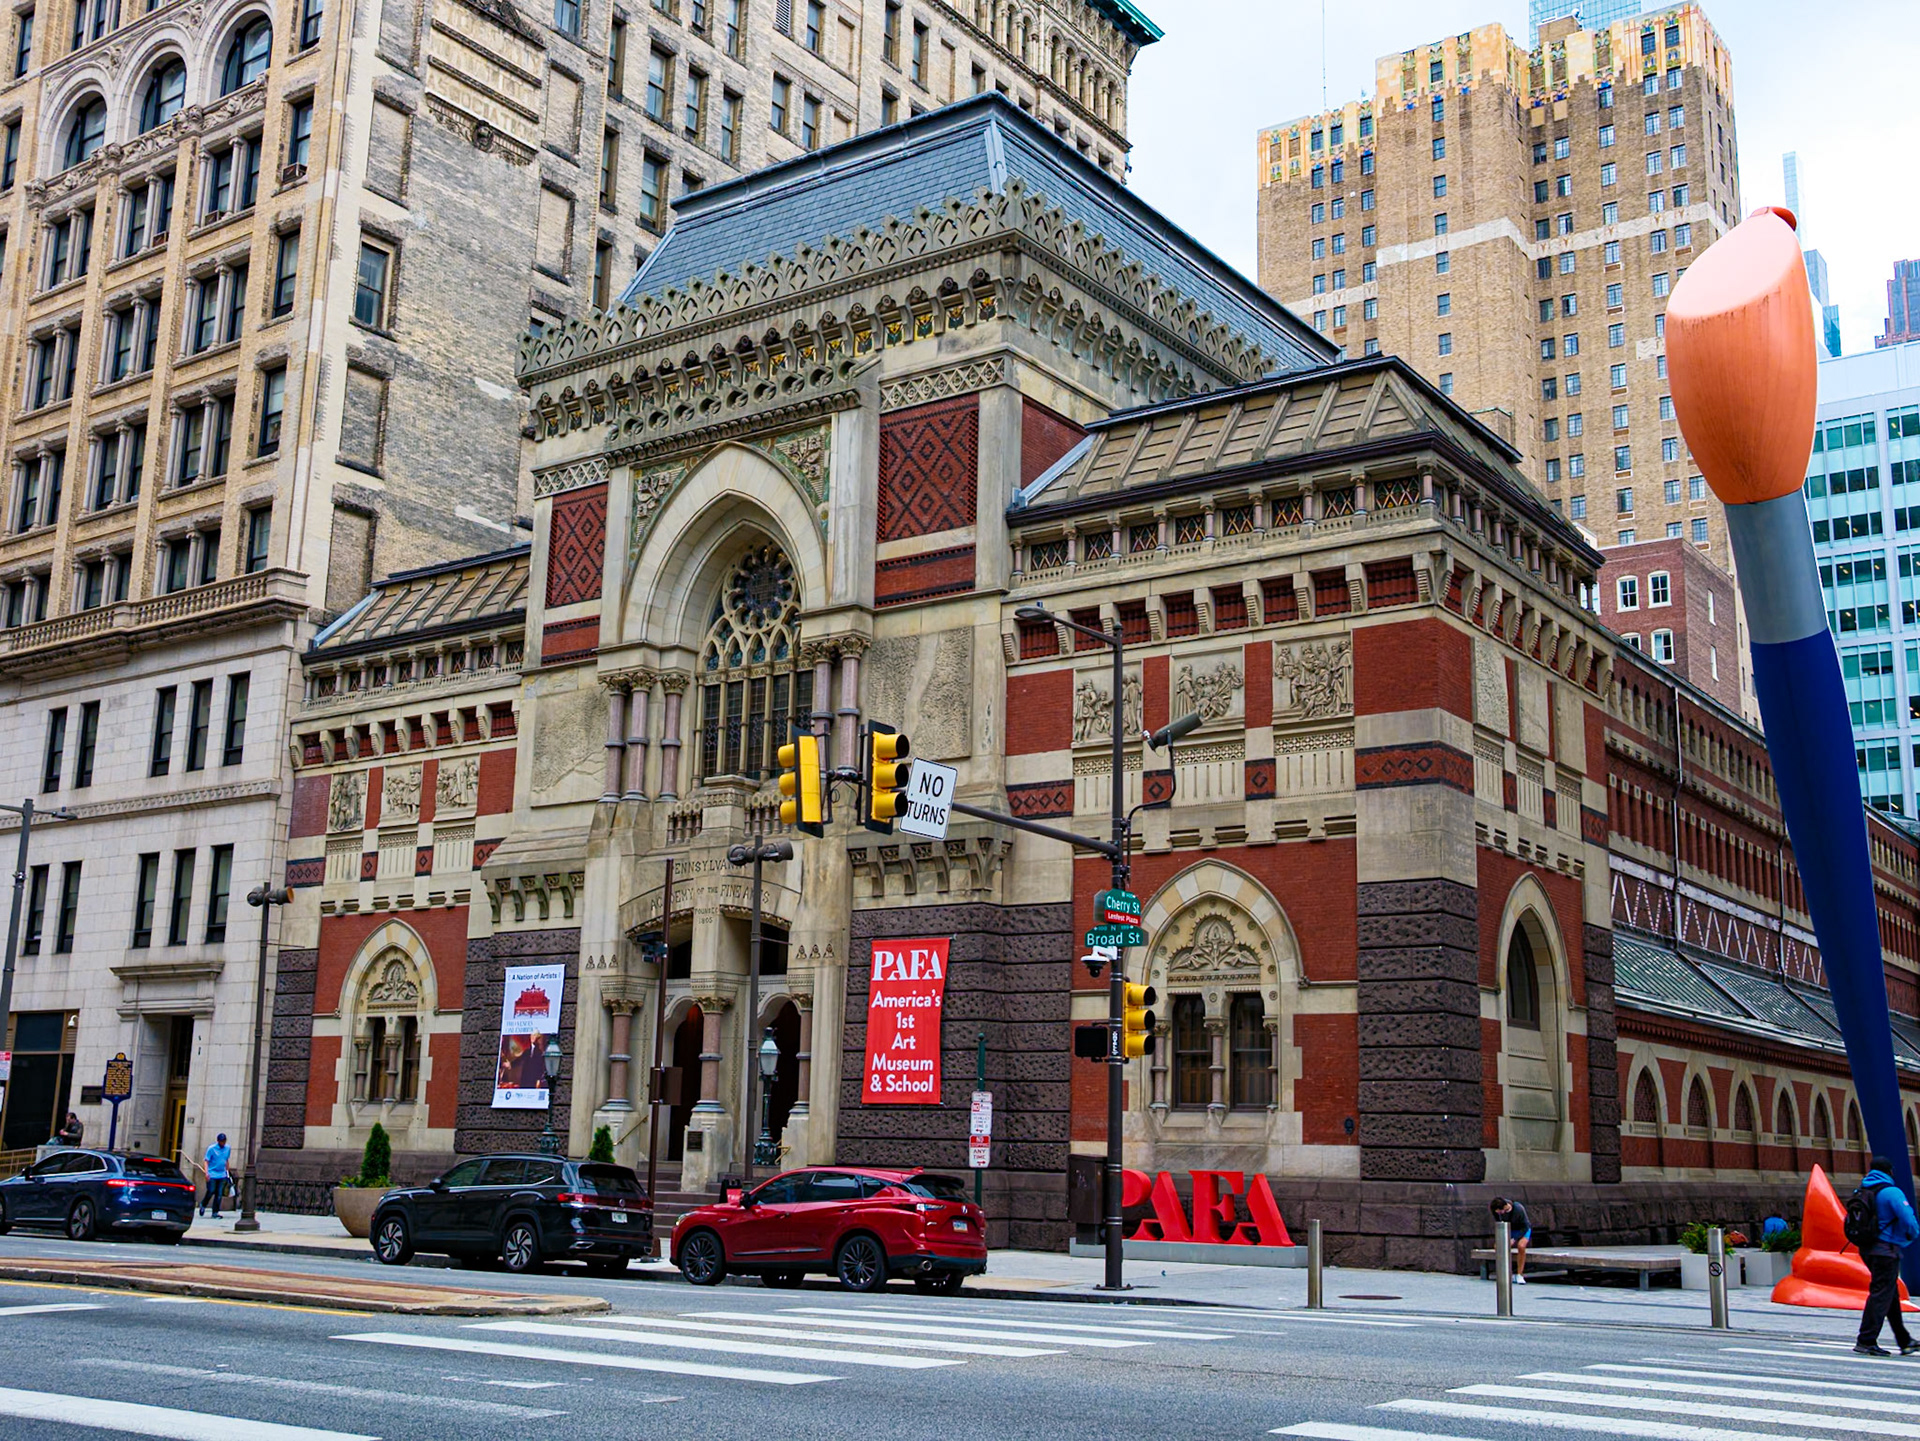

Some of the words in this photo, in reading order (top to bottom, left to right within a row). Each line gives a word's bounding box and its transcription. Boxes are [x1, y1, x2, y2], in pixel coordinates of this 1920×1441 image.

[919, 772, 944, 797] NO
[907, 800, 946, 826] TURNS
[650, 887, 694, 911] ACDEMY
[696, 887, 705, 895] OF
[707, 886, 718, 894] THE
[720, 884, 742, 899] FINE
[742, 885, 770, 904] AS
[1106, 896, 1131, 913] Cherry
[1132, 902, 1140, 914] St
[698, 916, 714, 924] 1805
[1107, 912, 1125, 921] Lenfest
[1126, 916, 1139, 924] Plaza
[1087, 932, 1123, 946] Broad
[1128, 932, 1140, 944] St
[871, 949, 943, 981] PAFA
[516, 973, 533, 981] Nation
[534, 972, 540, 980] of
[540, 972, 558, 980] Artists
[871, 988, 941, 1008] America's
[895, 1011, 915, 1029] 1st
[891, 1031, 916, 1050] Art
[871, 1052, 934, 1071] Museum
[870, 1075, 882, 1092] &
[885, 1074, 934, 1093] School
